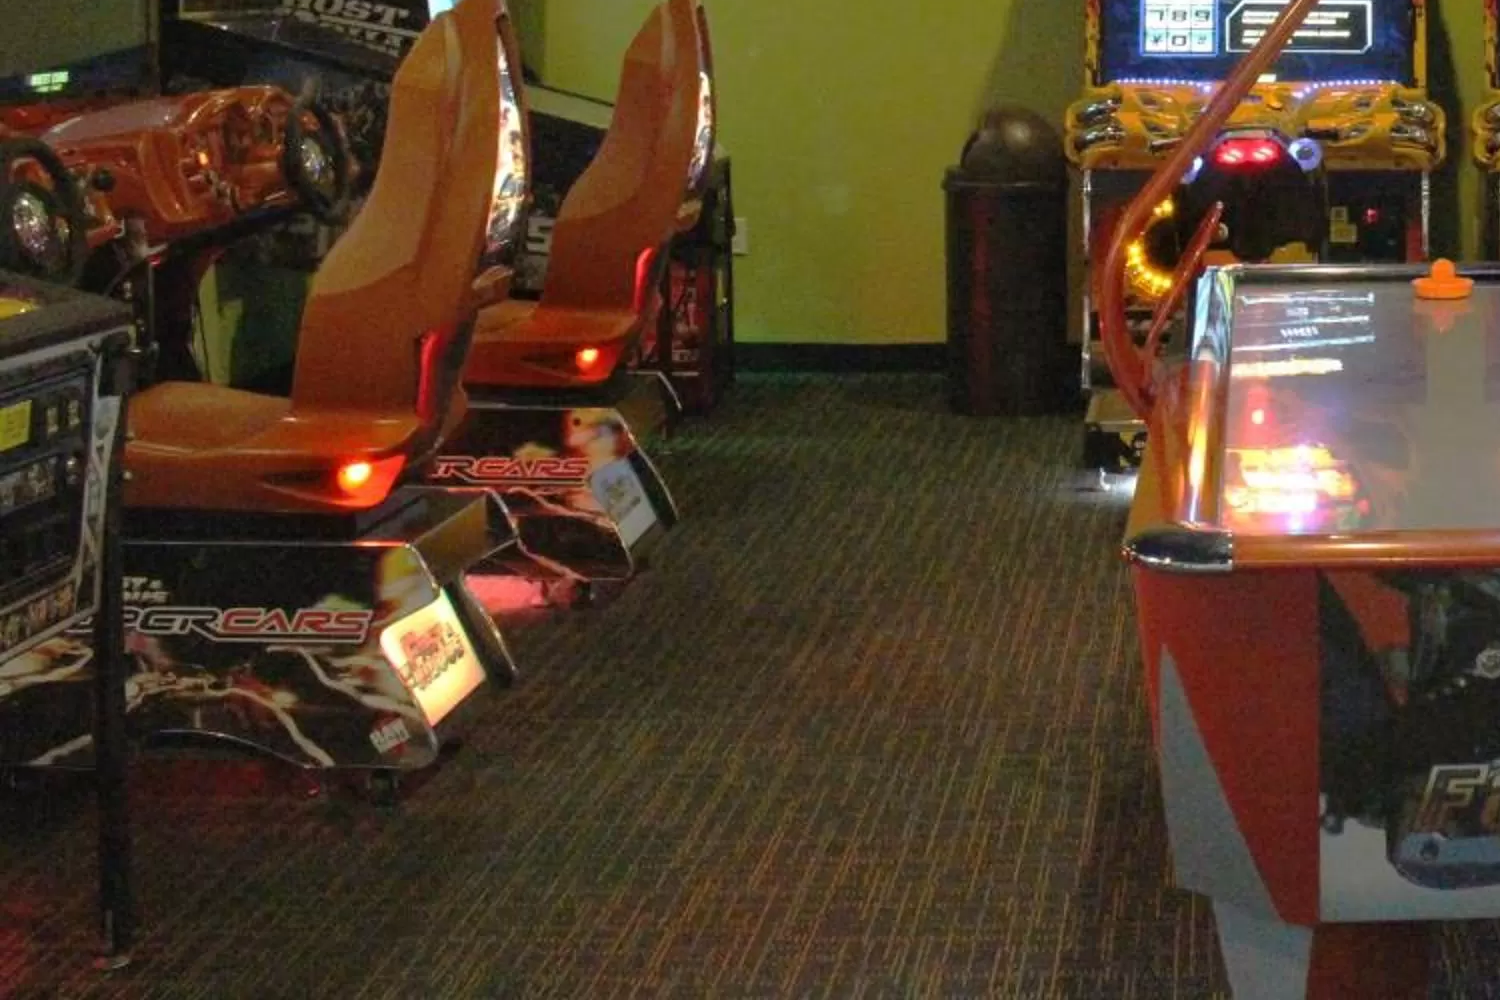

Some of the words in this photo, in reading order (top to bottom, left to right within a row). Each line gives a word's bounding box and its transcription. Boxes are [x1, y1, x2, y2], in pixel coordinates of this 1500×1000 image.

[1149, 9, 1164, 22] 7
[1172, 10, 1187, 22] 8
[1194, 10, 1210, 22] 9
[1171, 34, 1187, 46] 0
